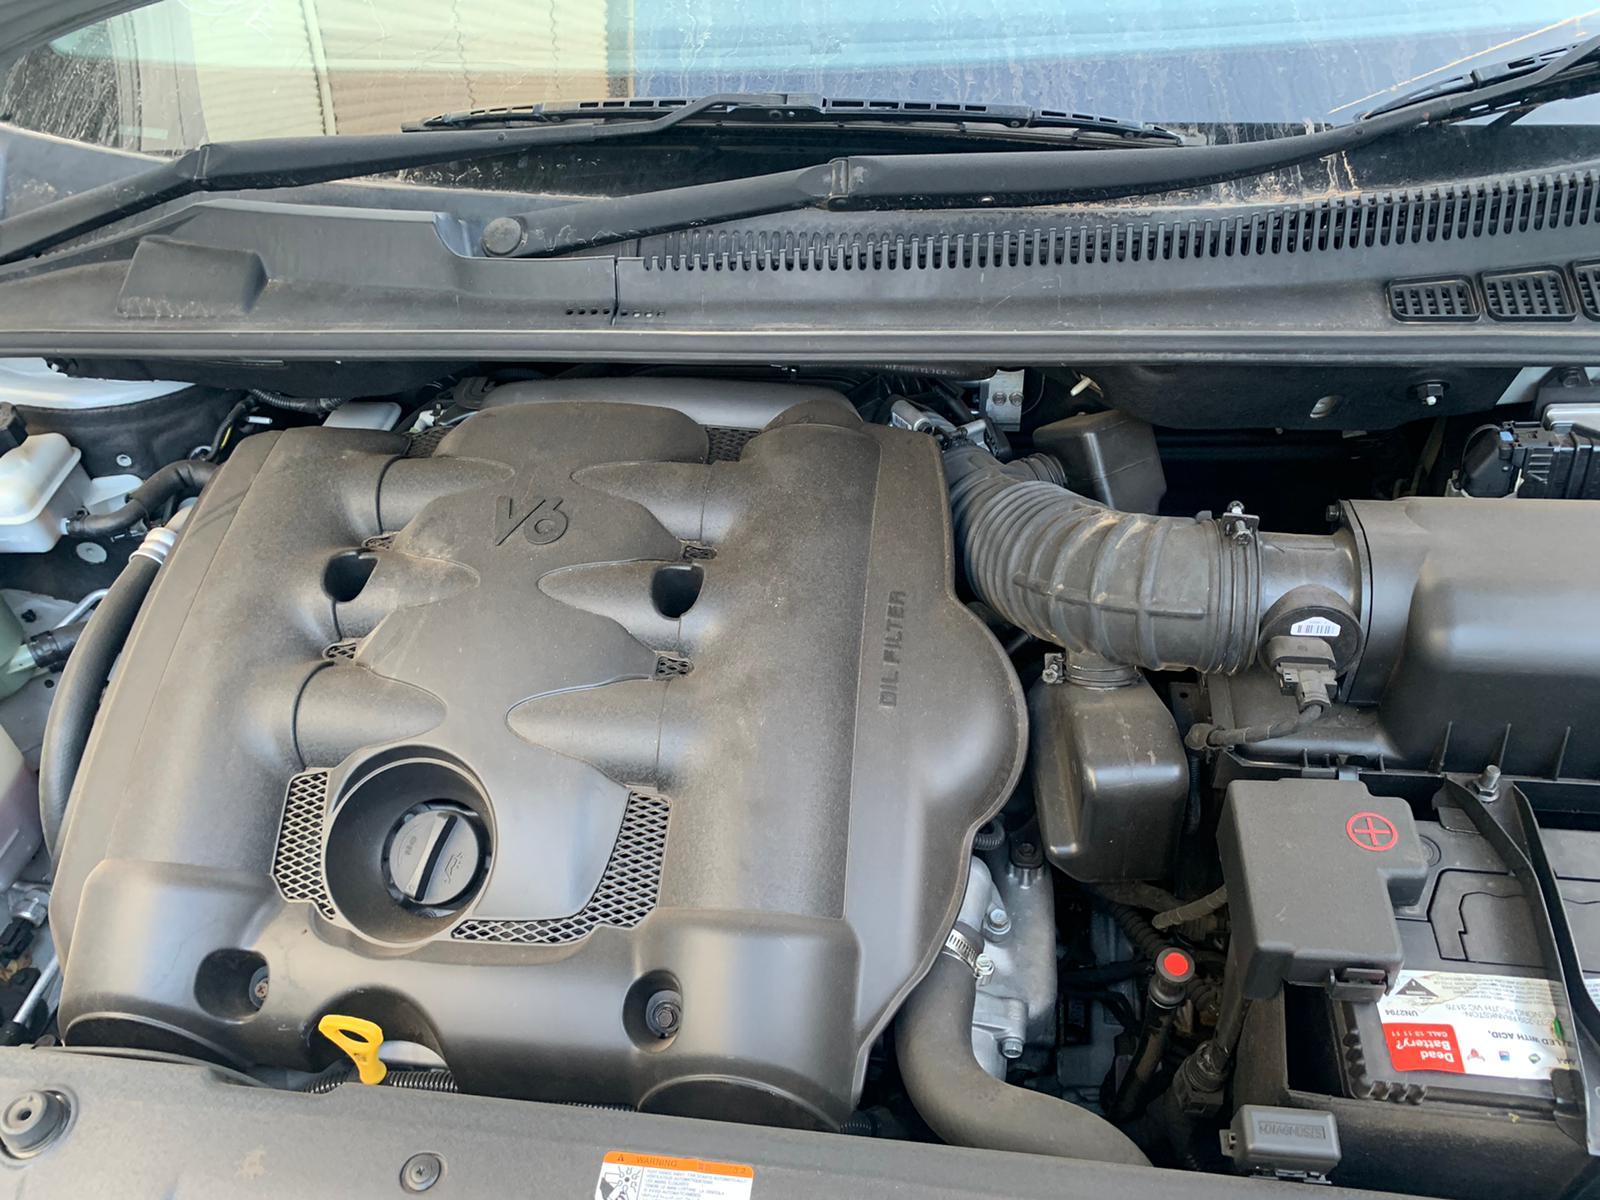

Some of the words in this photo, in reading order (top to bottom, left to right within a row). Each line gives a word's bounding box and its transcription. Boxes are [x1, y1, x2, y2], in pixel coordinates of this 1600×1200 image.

[495, 497, 569, 546] V6
[883, 590, 906, 664] FILTER
[879, 670, 899, 706] OIL
[1385, 1008, 1419, 1016] UN2794
[1426, 1030, 1448, 1038] CALL
[1517, 1033, 1540, 1043] WITH
[1396, 1038, 1451, 1051] Battery?
[1420, 1050, 1455, 1063] Dead
[636, 1156, 677, 1167] WARNING
